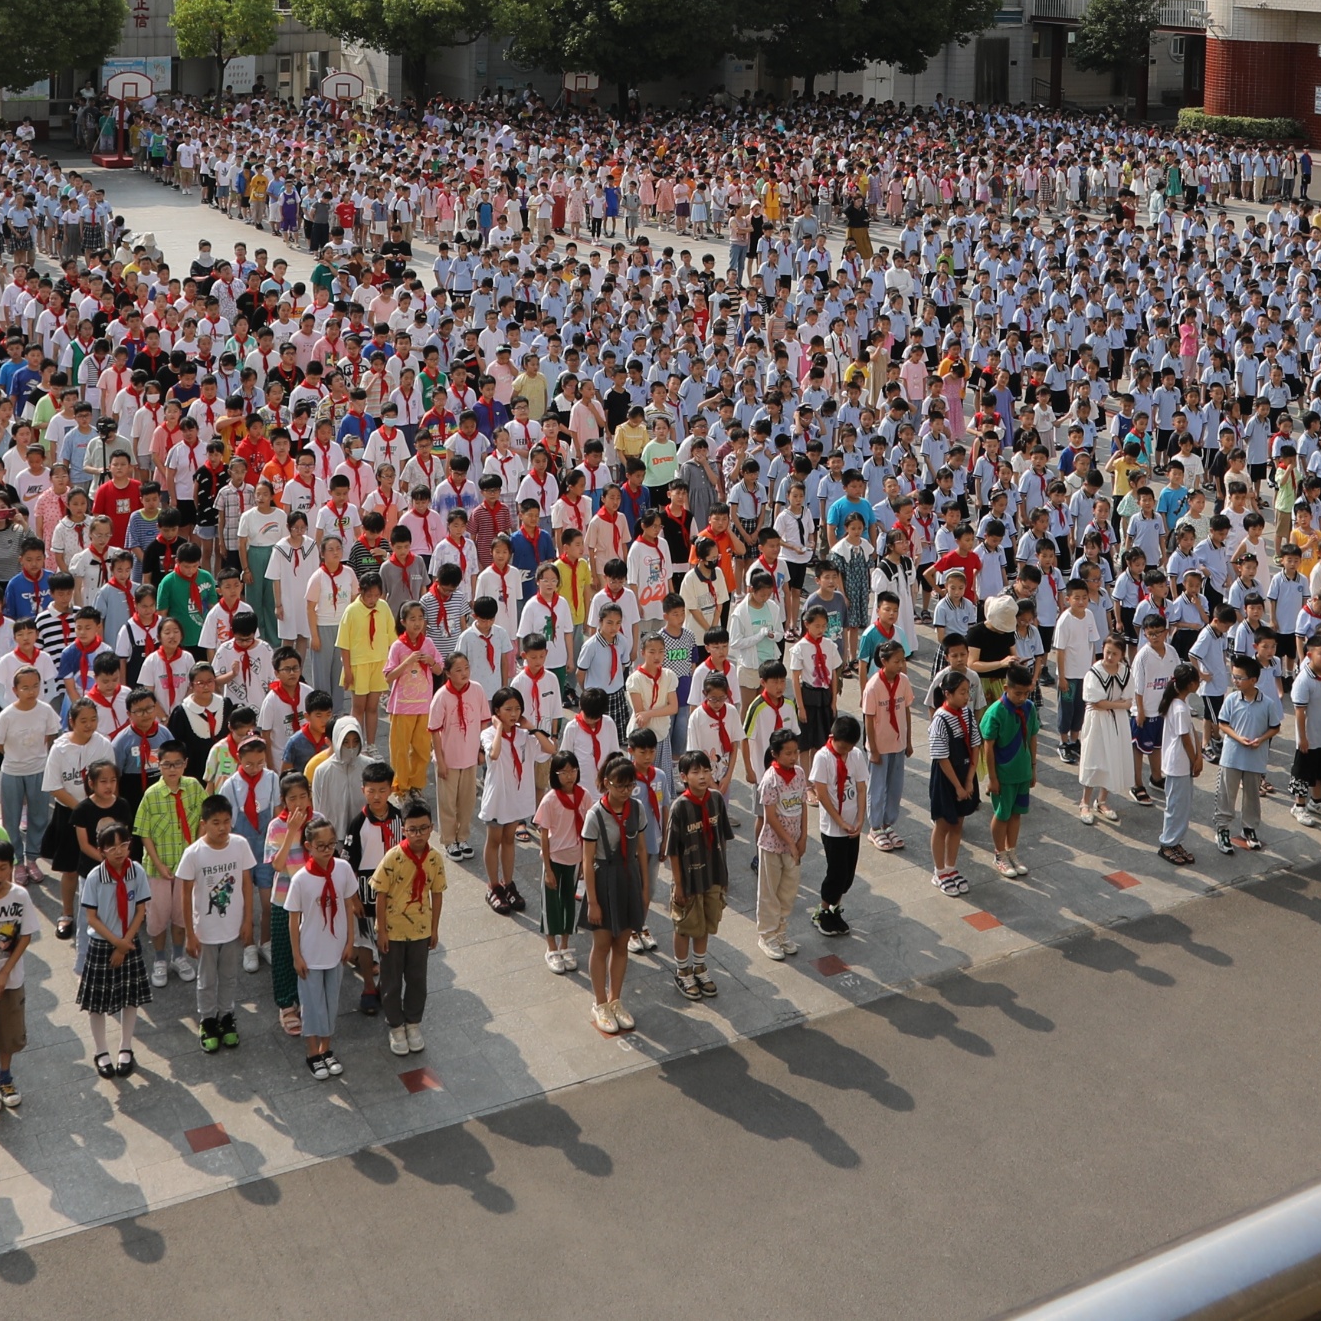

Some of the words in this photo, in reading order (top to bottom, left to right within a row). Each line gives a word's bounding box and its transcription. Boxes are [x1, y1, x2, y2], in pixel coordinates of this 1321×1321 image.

[27, 484, 43, 494] NIKE
[21, 589, 51, 600] CHNA
[667, 648, 688, 661] 1233
